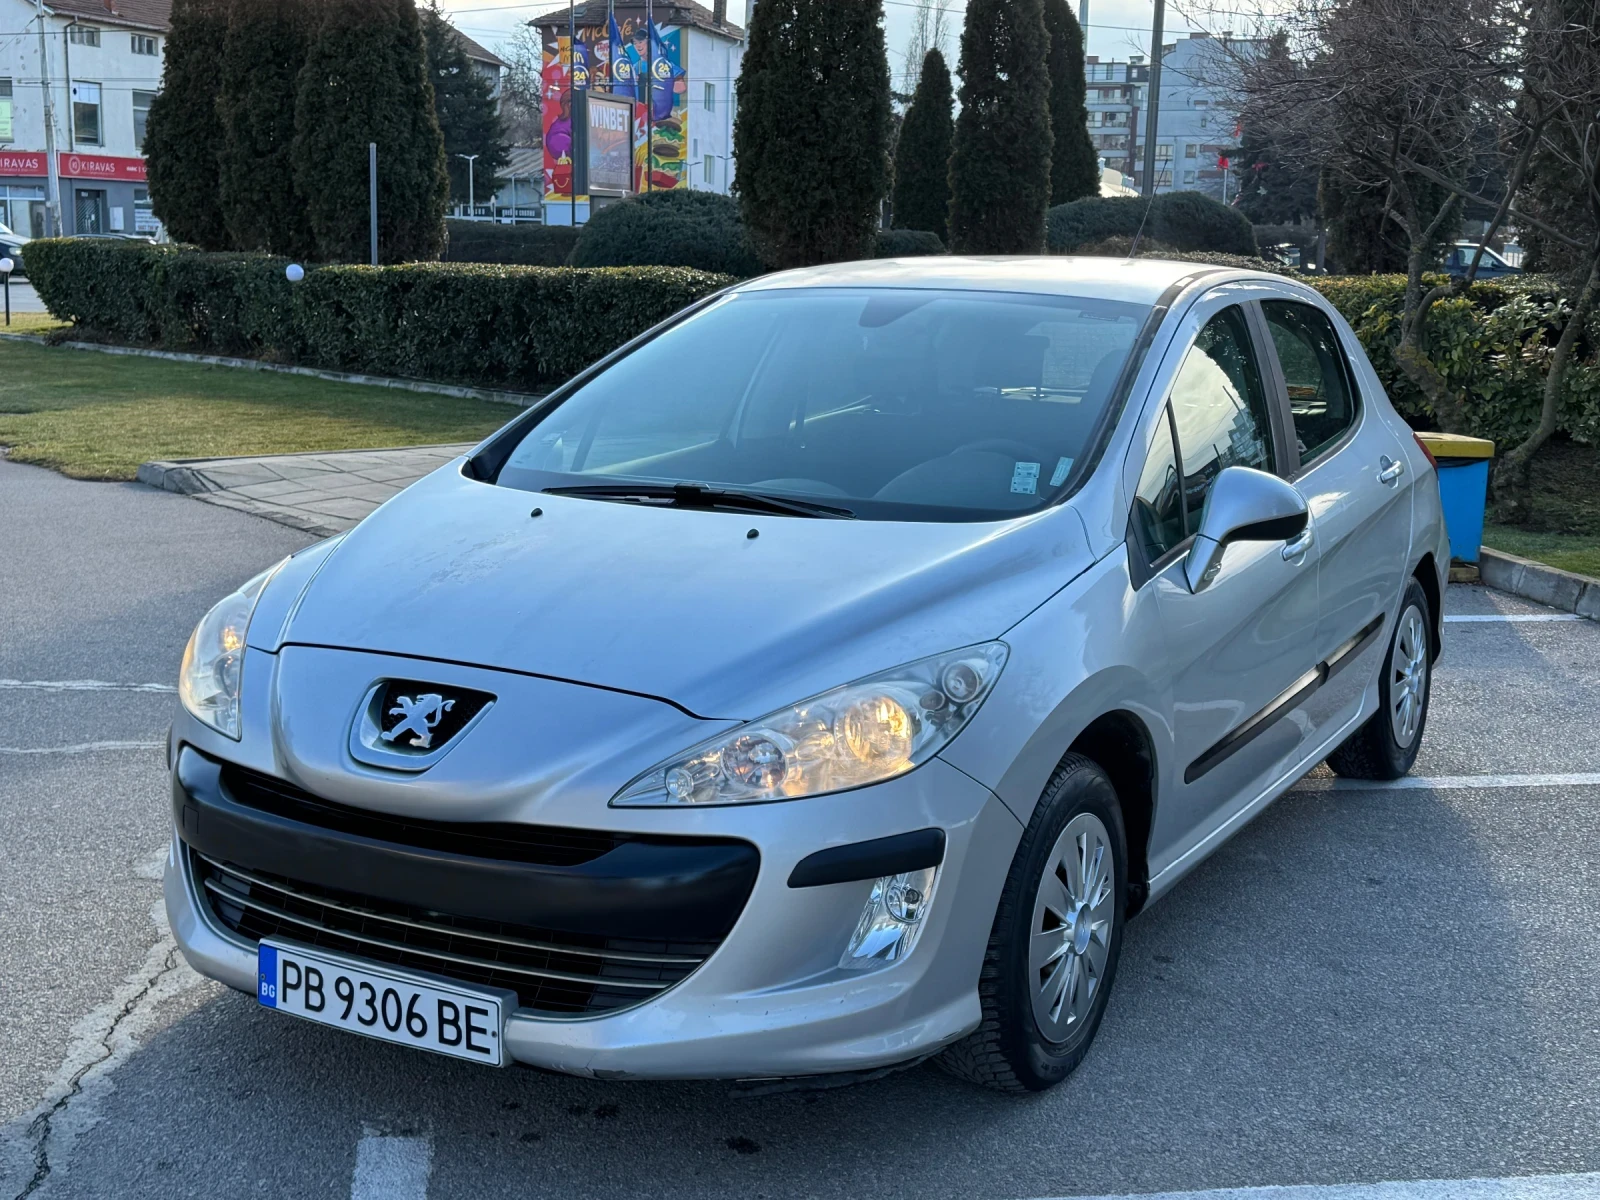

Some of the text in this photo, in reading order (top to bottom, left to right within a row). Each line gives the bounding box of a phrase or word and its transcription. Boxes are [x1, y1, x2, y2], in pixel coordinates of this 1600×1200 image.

[619, 63, 631, 73] 24
[658, 62, 670, 73] 24
[574, 71, 586, 81] 24
[81, 160, 116, 173] KIRAVAS
[261, 981, 276, 999] BG
[282, 958, 491, 1055] PB 9306 BE
